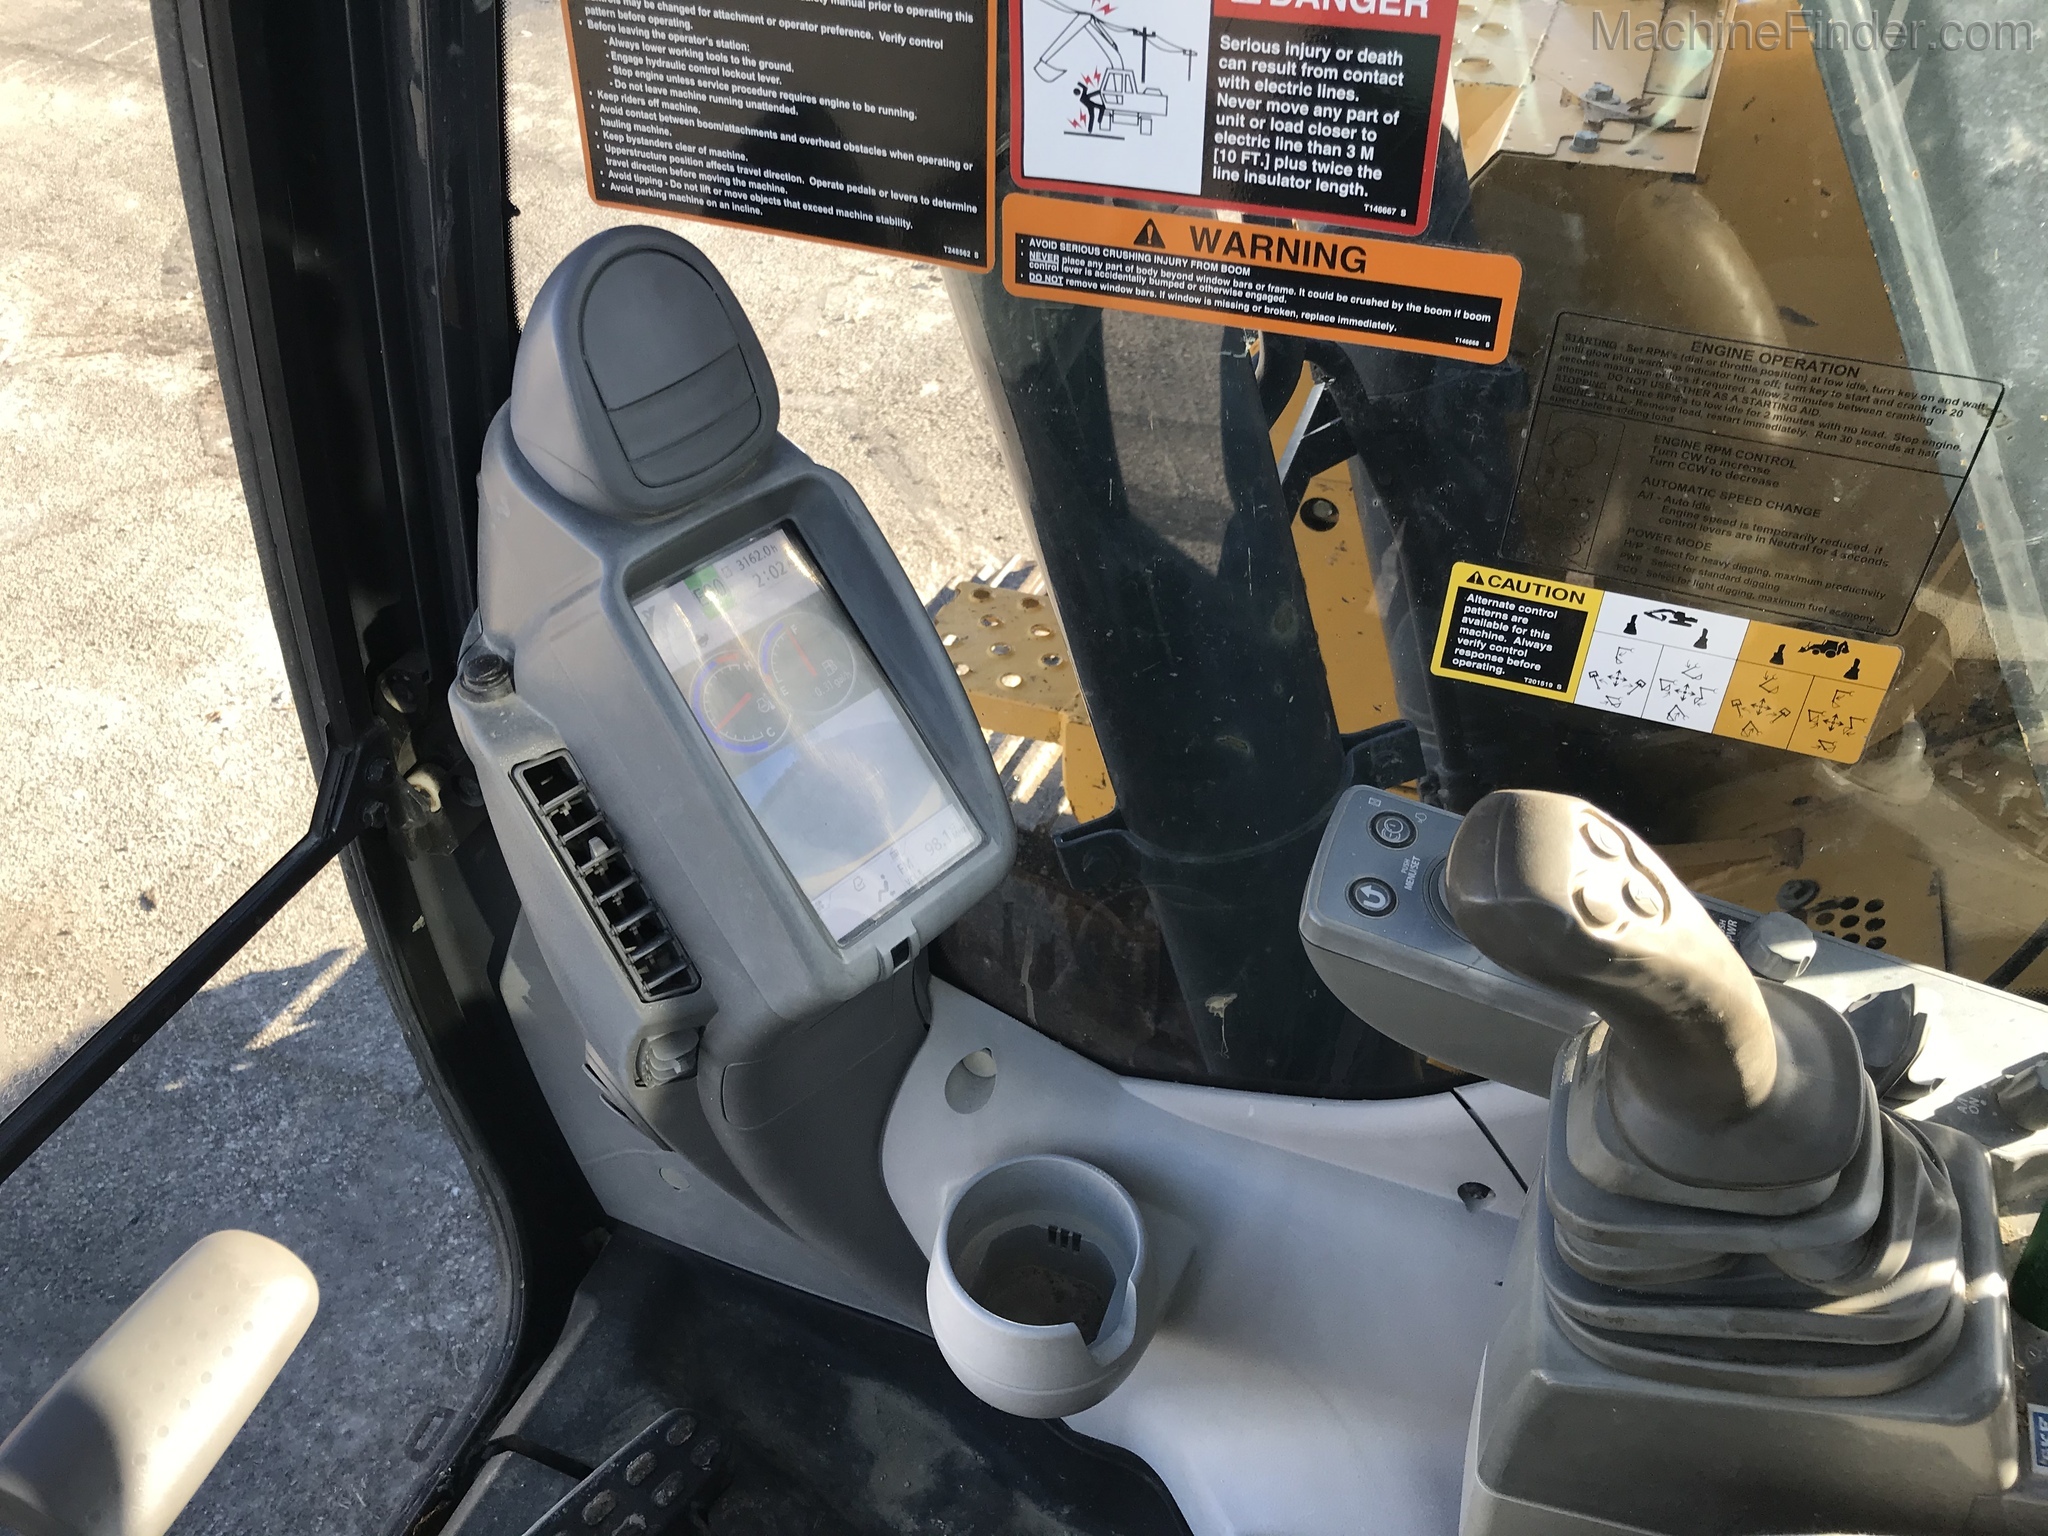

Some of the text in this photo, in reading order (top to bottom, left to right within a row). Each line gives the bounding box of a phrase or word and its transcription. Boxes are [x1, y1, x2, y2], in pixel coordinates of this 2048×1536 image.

[586, 20, 750, 52] Before leaving the operator's station:
[1219, 34, 1403, 66] Serious injury or death
[608, 36, 794, 73] Always lower working tools to the ground.
[610, 50, 782, 85] Engage hydraulic control lockout lever.
[1218, 56, 1404, 87] can result from contact
[596, 89, 701, 115] Keep riders off machine.
[1217, 73, 1359, 102] with electric lines.
[1216, 91, 1400, 125] Never move any part of
[1215, 112, 1377, 142] unit or load closer to
[1213, 130, 1374, 161] electric line than 3 M
[1213, 147, 1382, 181] [10 FT.] plus twice the
[1212, 164, 1368, 198] line insulator length.
[1028, 237, 1251, 277] AVOID SERIOUS CRUSHING INJURY FROM BOOM
[1189, 225, 1367, 274] WARNING
[1028, 259, 1287, 304] control lever is accidentally bumped or otherwise engaged.
[1028, 249, 1491, 323] NEVER place any part of body beyond window bars or frame. It could be crushed by the boom if boom
[1028, 271, 1397, 333] DO NOT remove window bars. If window is missing or broken, replace immediately.
[1689, 339, 1861, 379] ENGINE OPERATION
[1653, 434, 1799, 469] ENGINE RPM CONTROL
[1640, 476, 1823, 519] AUTOMATIC SPEED CHANGE
[1488, 575, 1585, 604] CAUTION
[1463, 605, 1529, 625] patterns are
[1465, 592, 1558, 619] Alternate control
[790, 624, 798, 635] F
[1458, 626, 1553, 652] machine. Always
[1461, 615, 1550, 640] available for this
[1454, 647, 1541, 671] response before
[1457, 636, 1528, 657] verify control
[743, 660, 753, 672] H
[1451, 657, 1505, 675] operating.
[780, 685, 789, 697] E
[766, 726, 776, 738] C
[1403, 855, 1421, 891] MENU/SET
[1968, 1096, 1980, 1115] ON
